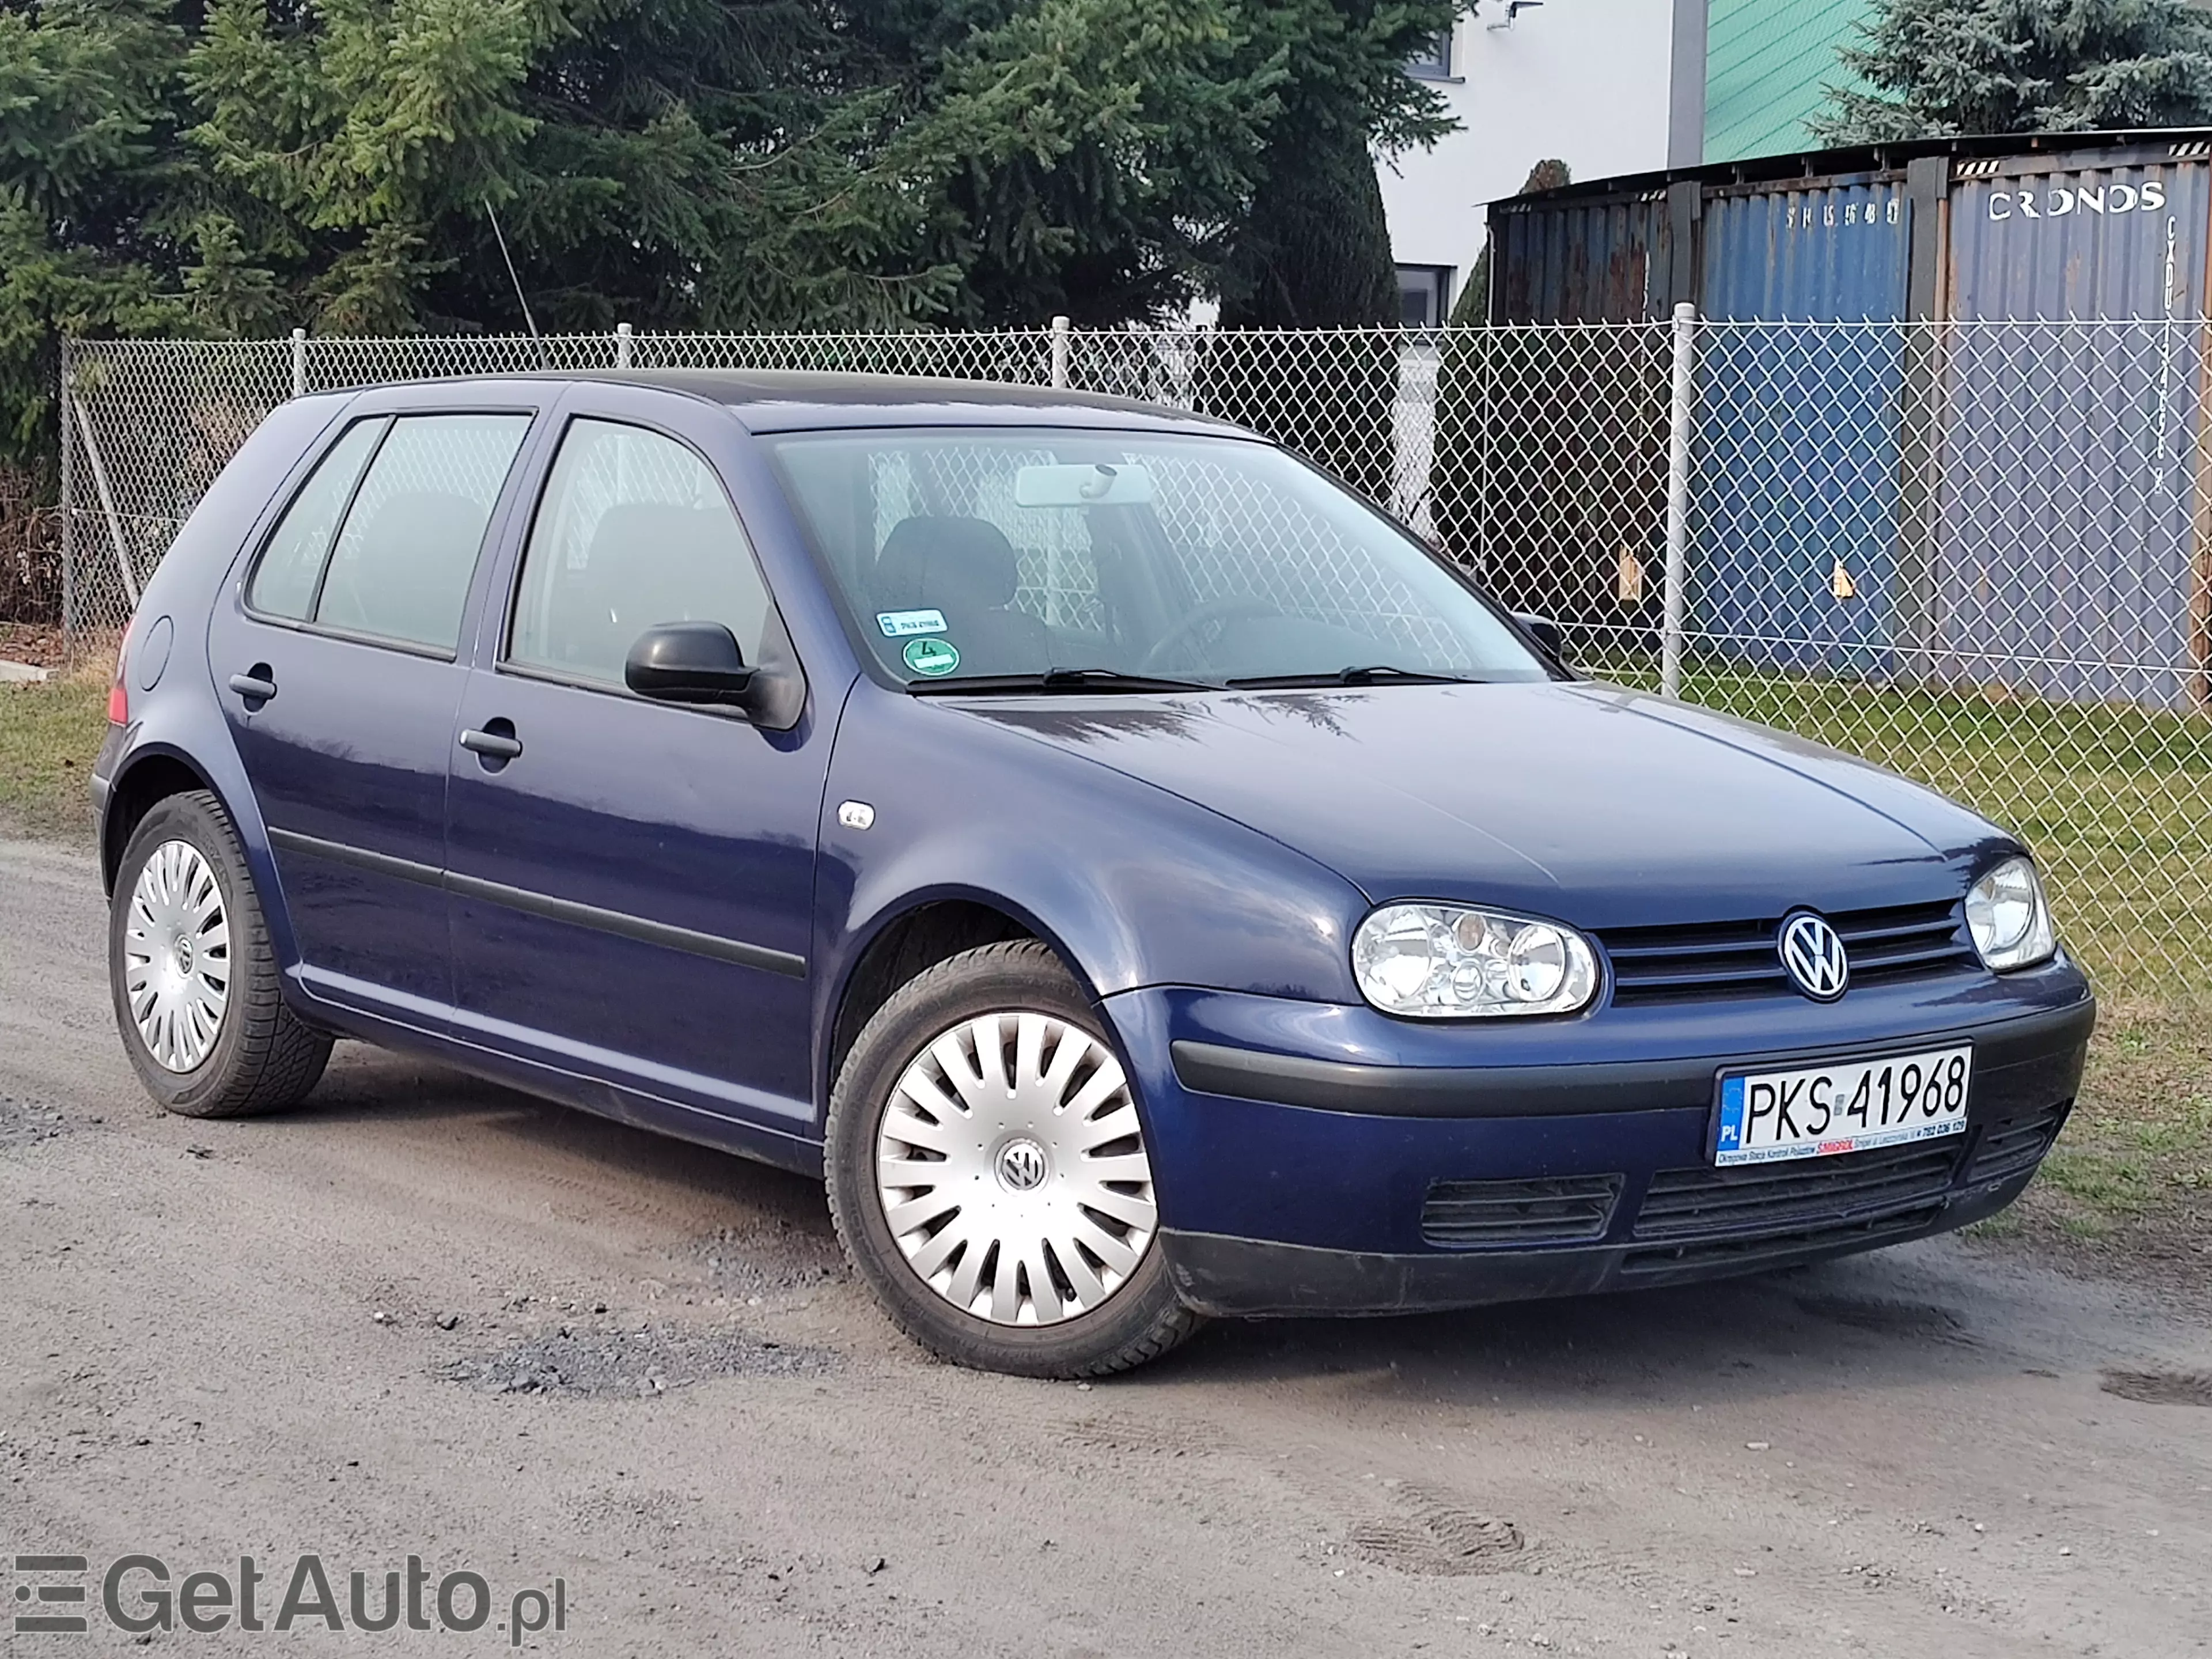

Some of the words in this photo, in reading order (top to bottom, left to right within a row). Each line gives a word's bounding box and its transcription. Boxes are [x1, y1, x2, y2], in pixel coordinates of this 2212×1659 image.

[1988, 181, 2166, 221] CRONOS
[921, 641, 937, 657] 4
[1784, 916, 1847, 995] VW
[1745, 1076, 1832, 1144] PKS
[1847, 1055, 1965, 1128] 41968
[1721, 1125, 1738, 1142] PL
